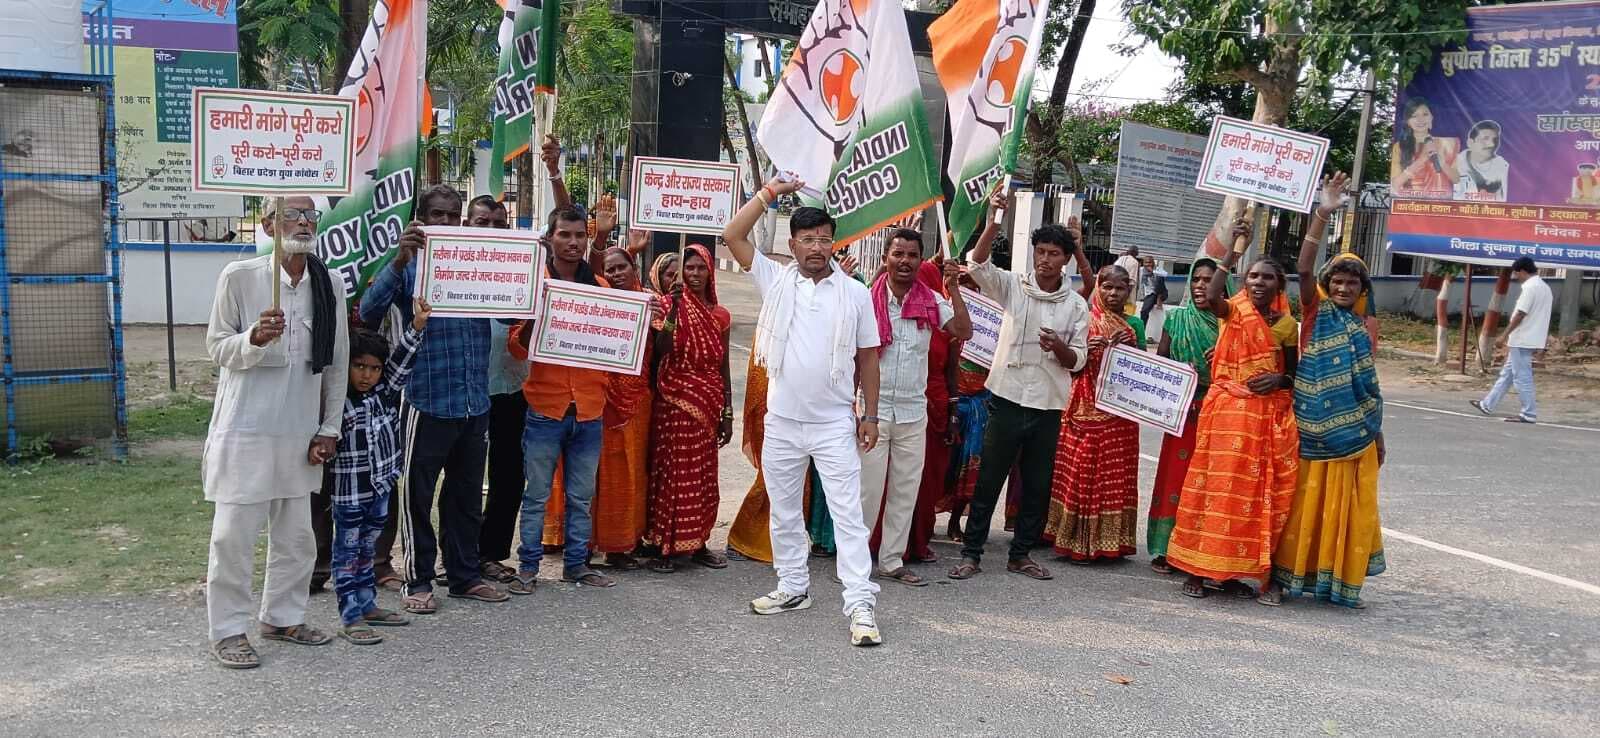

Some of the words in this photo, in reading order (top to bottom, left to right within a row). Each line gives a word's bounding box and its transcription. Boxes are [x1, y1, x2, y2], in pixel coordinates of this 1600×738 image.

[1441, 46, 1485, 77] सुपौल
[1489, 44, 1533, 69] जिला
[209, 103, 253, 131] हमारी
[256, 107, 288, 132] मांगे
[291, 108, 314, 143] पूरी
[316, 110, 343, 135] करो
[231, 140, 250, 164] पूरी
[302, 145, 322, 161] करो
[1221, 132, 1251, 150] हमारी
[1251, 137, 1275, 155] मांगे
[1275, 141, 1292, 164] पूरी
[1293, 147, 1314, 164] करो
[233, 165, 255, 176] बिहार
[257, 166, 277, 178] प्रदेश
[279, 169, 293, 181] युवा
[1229, 158, 1242, 173] पूरी
[1277, 169, 1293, 181] करो
[645, 168, 665, 191] केन्द्र
[665, 169, 680, 189] और
[681, 175, 702, 190] राज्य
[703, 177, 732, 193] सरकार
[661, 194, 712, 209] हाय-हाय
[1397, 202, 1430, 214] कार्यक्रम
[1431, 204, 1451, 214] स्थल
[1511, 207, 1537, 220] सुपौल
[656, 210, 671, 218] बिहार
[686, 213, 695, 221] युवा
[1534, 224, 1581, 239] निवेदक
[459, 247, 475, 263] प्रखंड
[476, 245, 488, 261] और
[489, 248, 505, 263] अंचल
[507, 253, 522, 264] भवन
[523, 253, 532, 264] का
[1450, 238, 1480, 251] जिला
[1482, 241, 1515, 256] सूचना
[1519, 243, 1538, 255] एवं
[1540, 246, 1563, 257] जन
[434, 265, 455, 281] निर्माण
[456, 270, 470, 281] जल्द
[471, 267, 477, 281] से
[478, 271, 492, 282] जल्द
[494, 272, 512, 283] कराया
[575, 301, 589, 315] प्रखंड
[589, 302, 600, 316] और
[600, 305, 616, 319] अंचल
[616, 310, 629, 321] भवन
[630, 312, 639, 322] का
[551, 316, 568, 331] निर्माण
[569, 322, 581, 332] जल्द
[581, 320, 588, 333] से
[588, 324, 601, 336] जल्द
[601, 326, 619, 338] कराया
